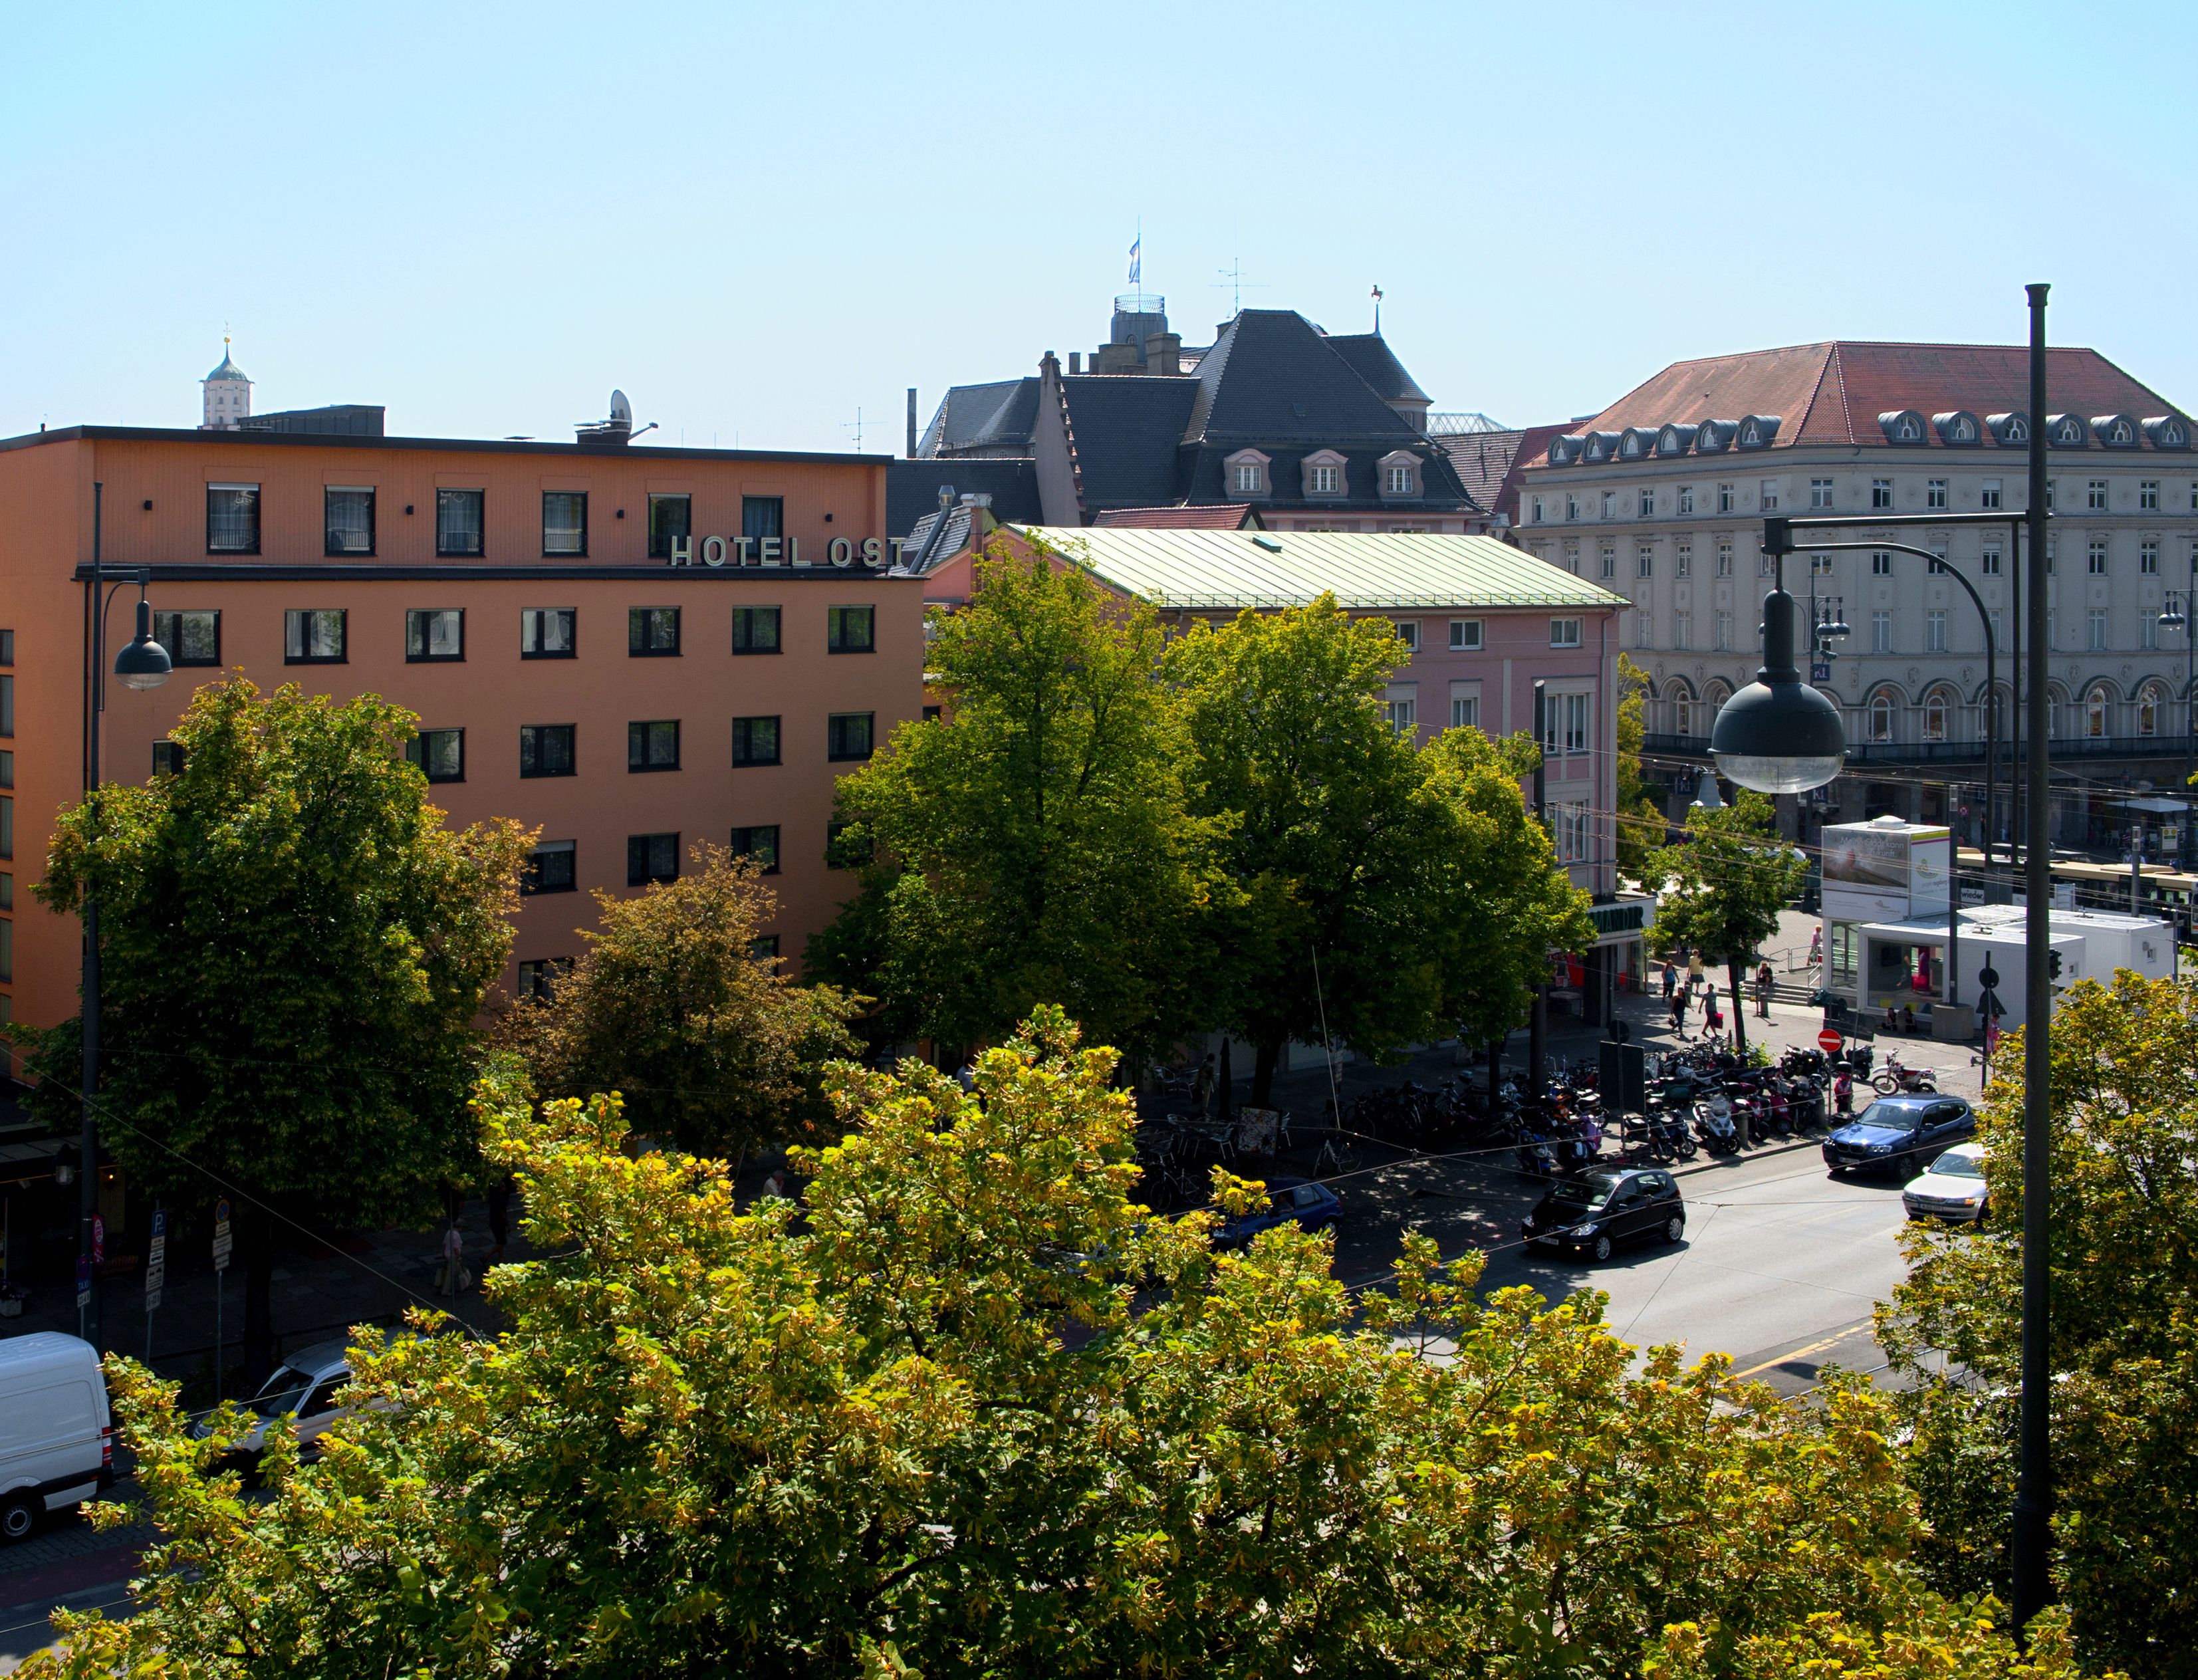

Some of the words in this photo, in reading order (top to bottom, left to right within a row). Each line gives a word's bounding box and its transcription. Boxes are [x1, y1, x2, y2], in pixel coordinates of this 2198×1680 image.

[670, 535, 812, 568] HOTEL
[829, 536, 908, 568] OST
[1840, 836, 1863, 846] Meine
[1866, 838, 1884, 848] Stadt
[1886, 840, 1904, 849] kann
[154, 1214, 163, 1233] P
[77, 1280, 89, 1292] TAXI
